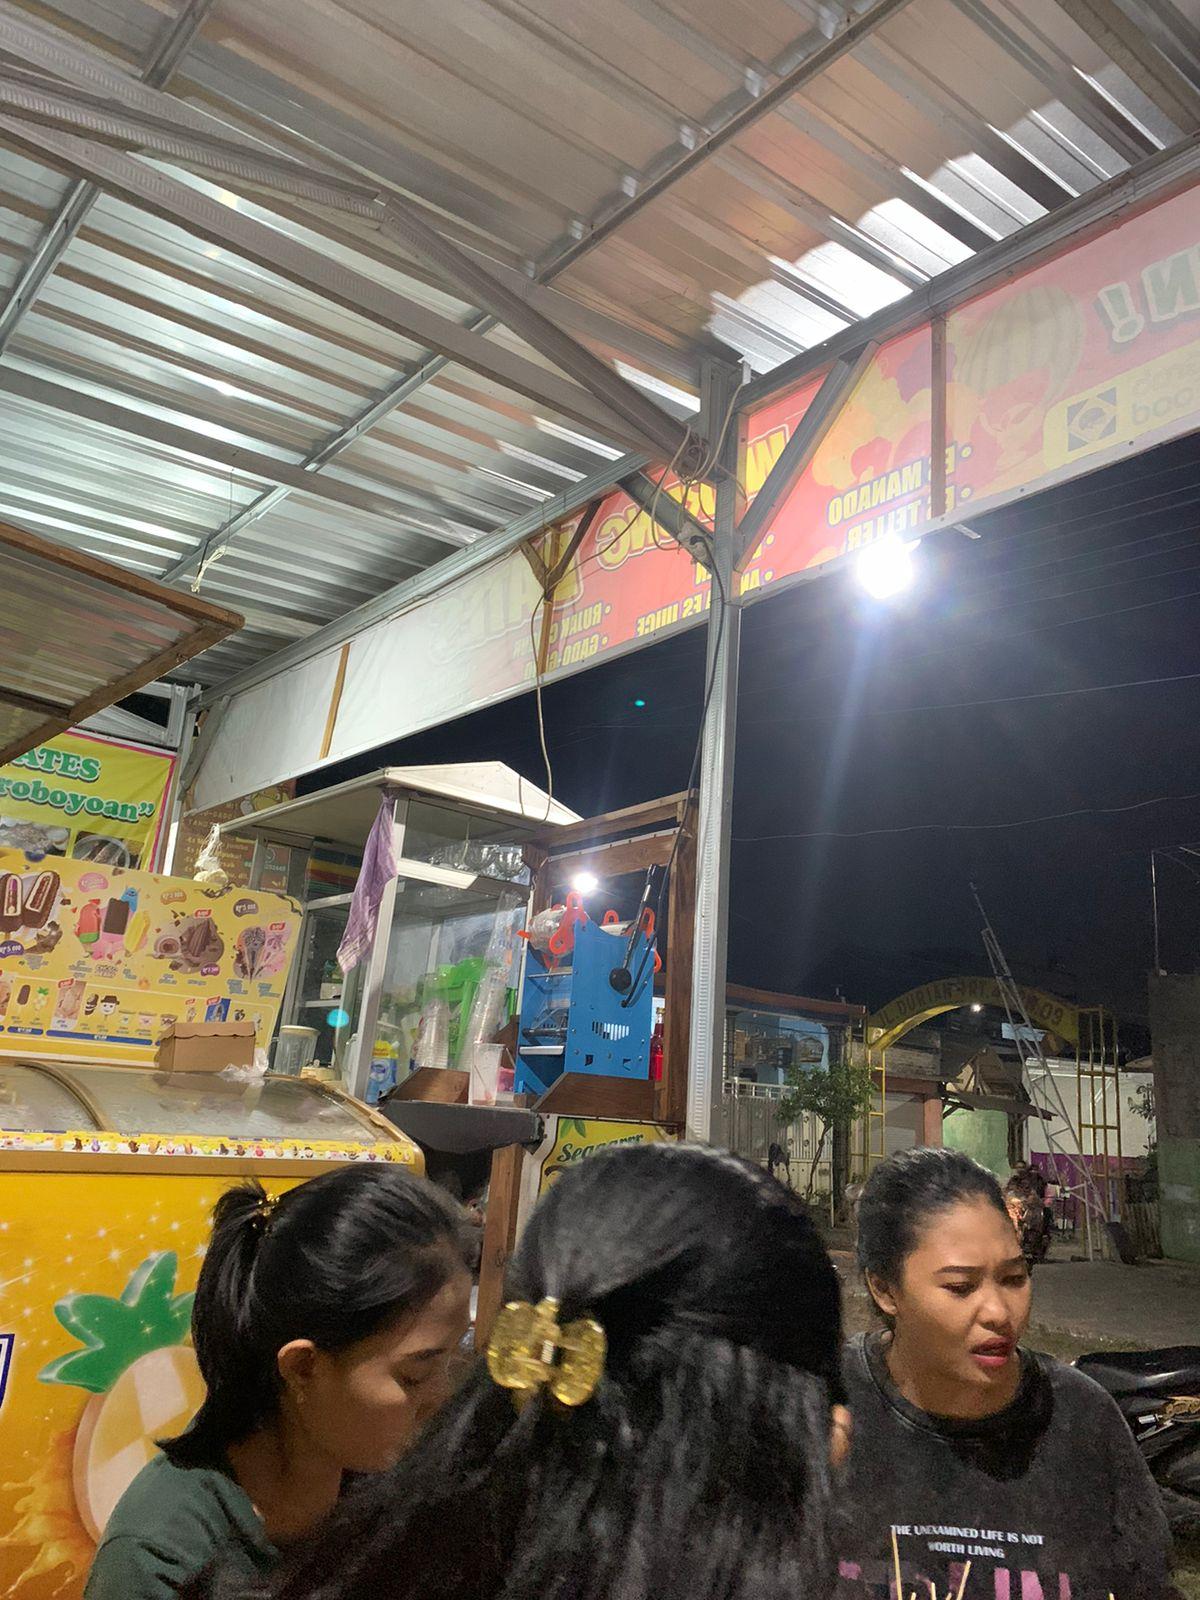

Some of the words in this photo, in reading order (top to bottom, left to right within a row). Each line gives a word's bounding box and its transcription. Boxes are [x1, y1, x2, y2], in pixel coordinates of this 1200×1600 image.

[890, 1525, 912, 1536] THE
[981, 1530, 1005, 1542] LIFE
[1007, 1532, 1019, 1543] IS
[1021, 1534, 1045, 1546] NOT
[927, 1542, 965, 1555] WORTH
[968, 1543, 1005, 1559] LIVING
